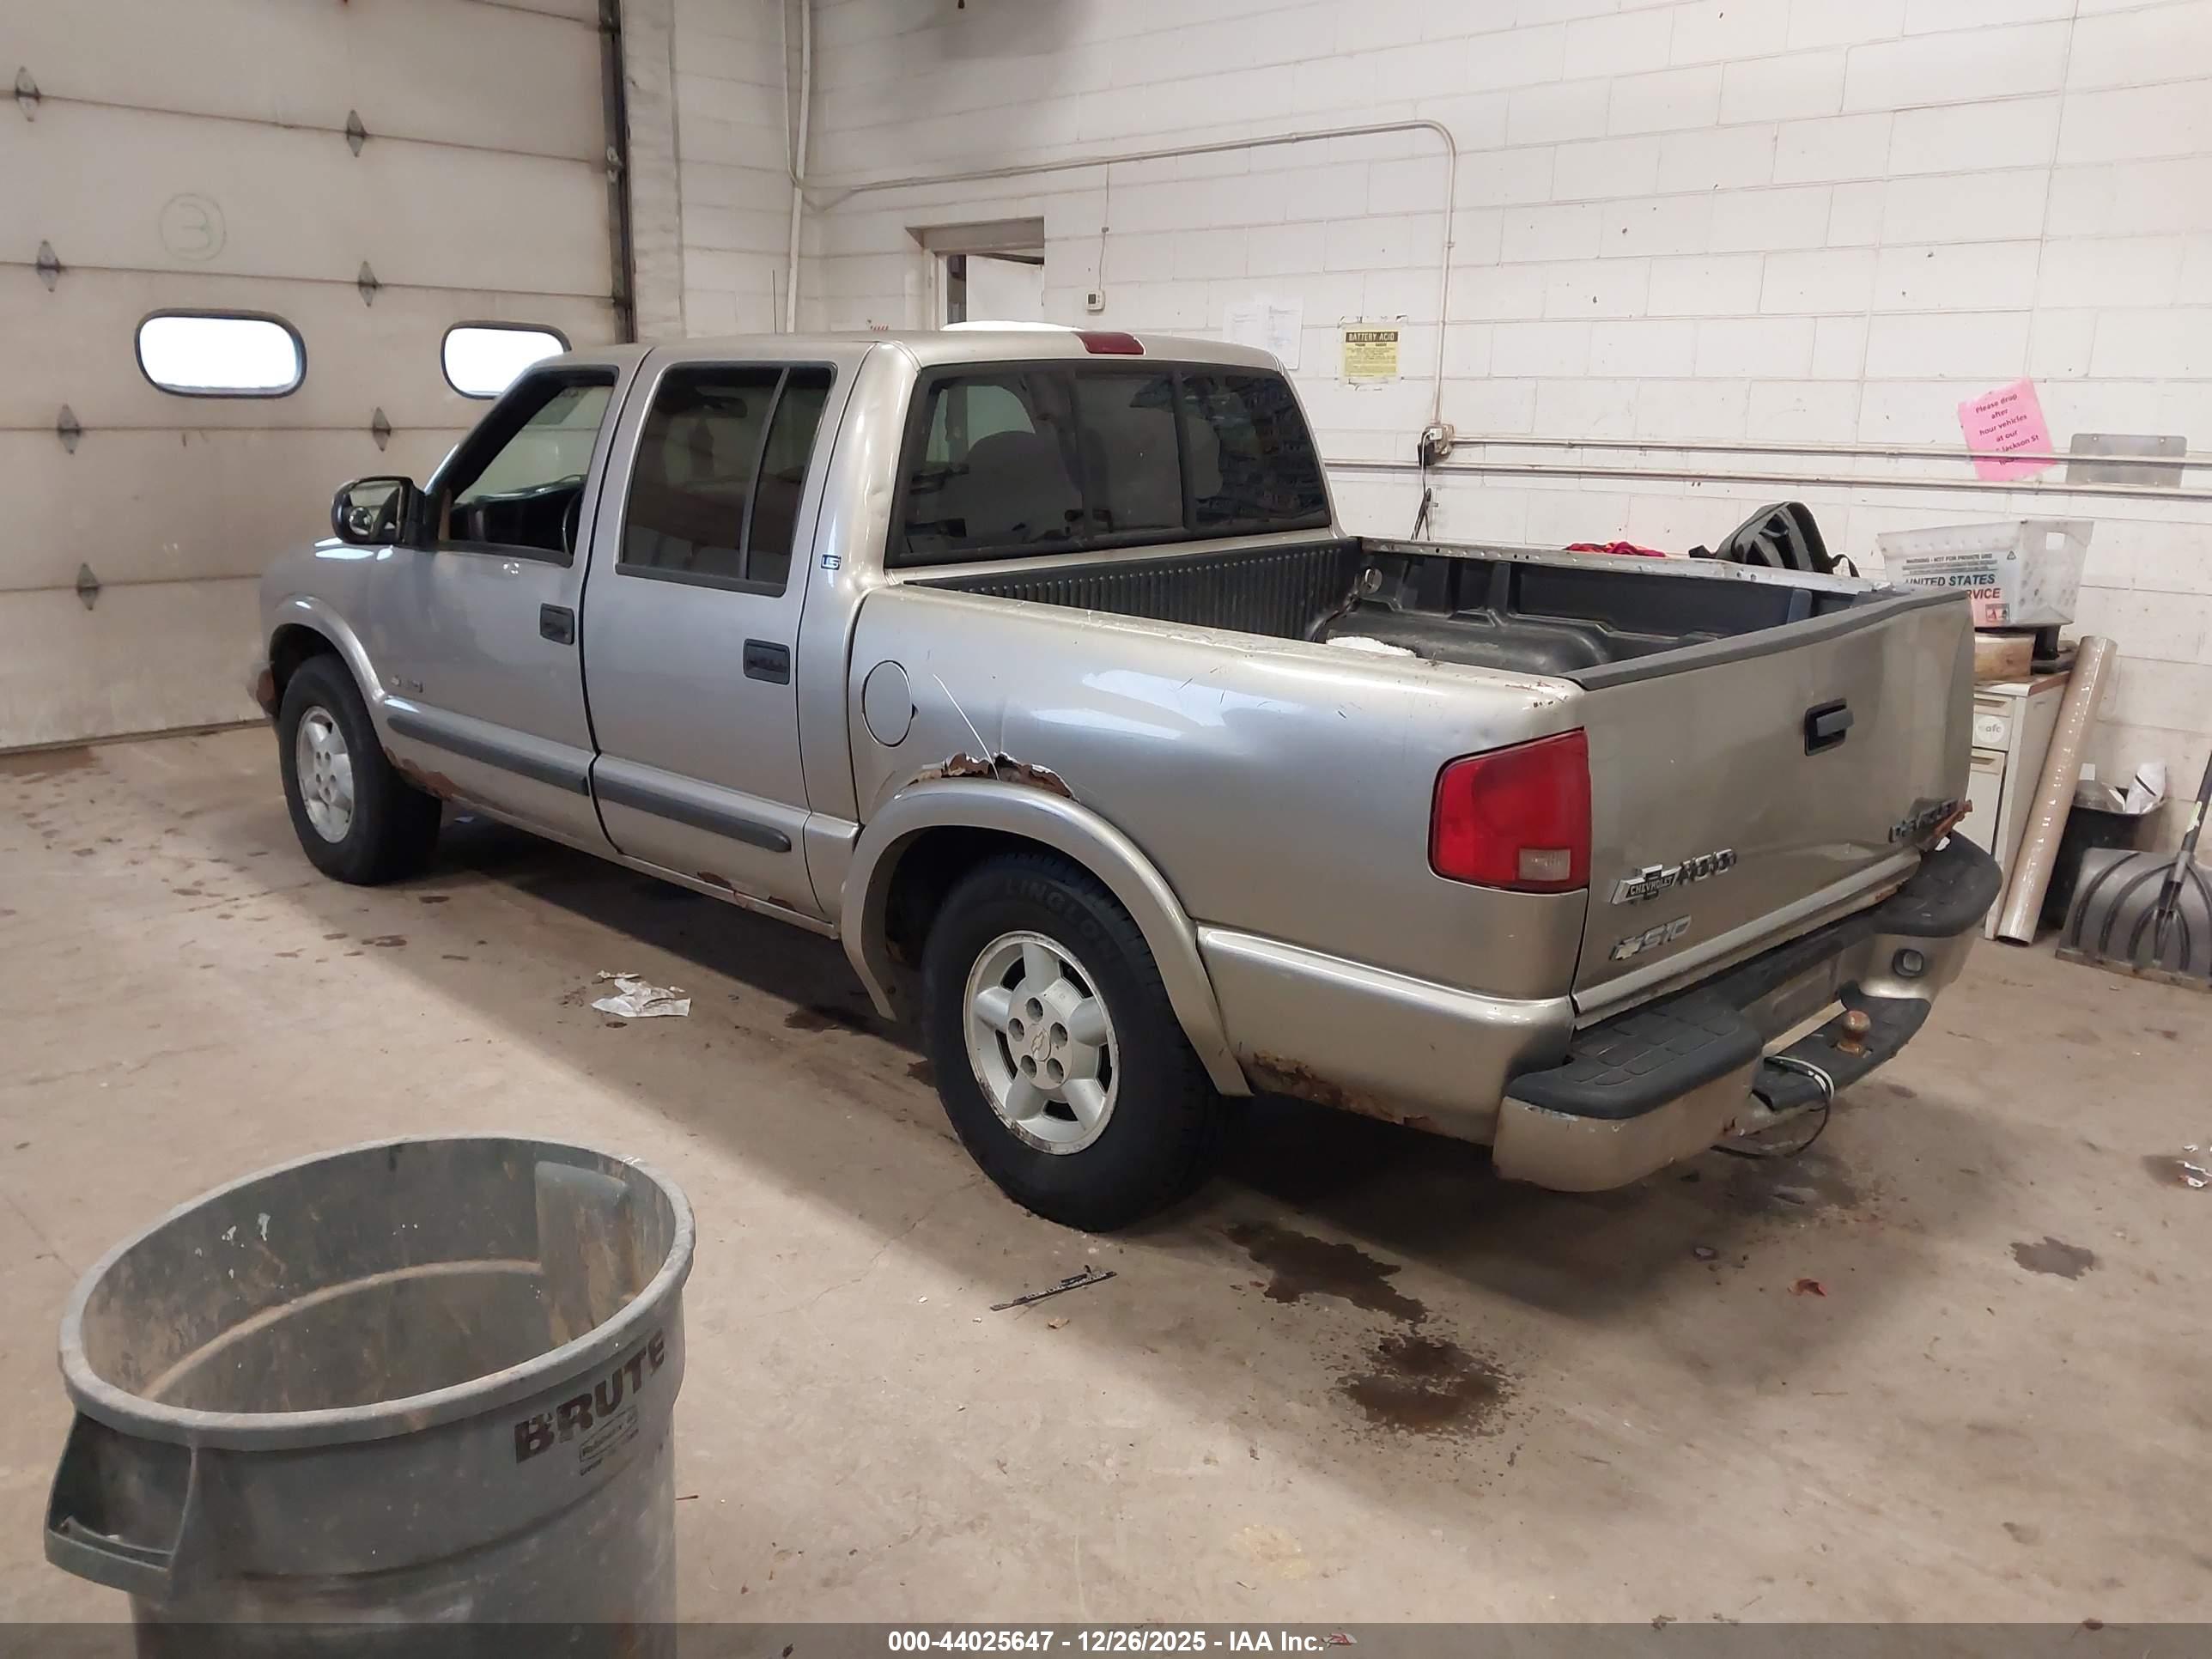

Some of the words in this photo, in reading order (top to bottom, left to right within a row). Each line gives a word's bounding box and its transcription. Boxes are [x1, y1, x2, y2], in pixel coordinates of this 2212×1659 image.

[1349, 332, 1376, 341] BATTERY
[1379, 332, 1395, 341] ACID
[1976, 401, 1999, 414] Please
[2001, 394, 2017, 404] drop
[1991, 409, 2008, 419] after
[1979, 425, 1996, 436] hour
[1998, 415, 2027, 428] vehicles
[2005, 430, 2018, 439] our
[2002, 439, 2030, 453] Jackson
[1906, 576, 1946, 586] UNITED
[1949, 574, 1996, 586] STATES
[1966, 587, 2002, 599] RVICE
[1630, 876, 1674, 895] CHEVROLET
[514, 1328, 665, 1463] BRUTE
